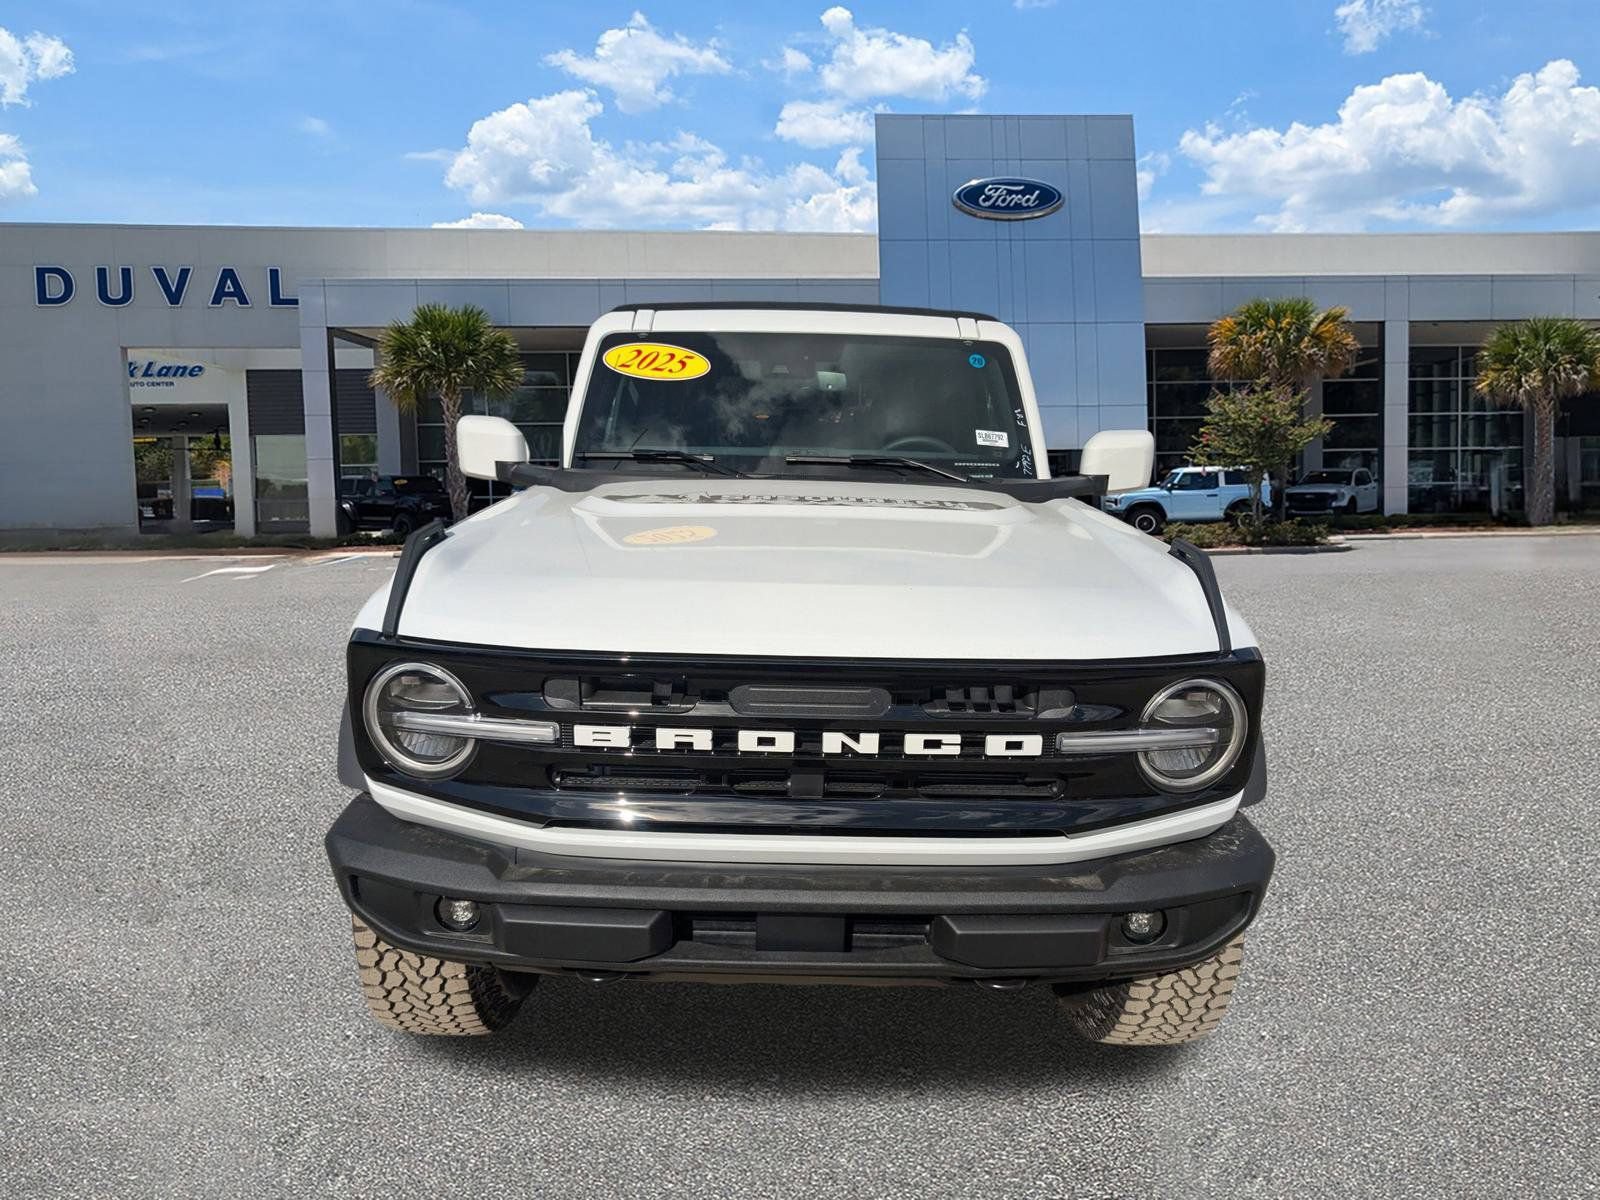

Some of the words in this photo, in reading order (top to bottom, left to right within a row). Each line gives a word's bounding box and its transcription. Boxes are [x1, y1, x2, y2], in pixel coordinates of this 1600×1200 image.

[978, 184, 1040, 207] Ford
[34, 265, 299, 307] DUVAL
[141, 361, 204, 378] Lane
[617, 348, 696, 374] 2025
[129, 380, 146, 388] UTO
[146, 380, 176, 388] CENTER
[572, 723, 1044, 758] BRONCO
